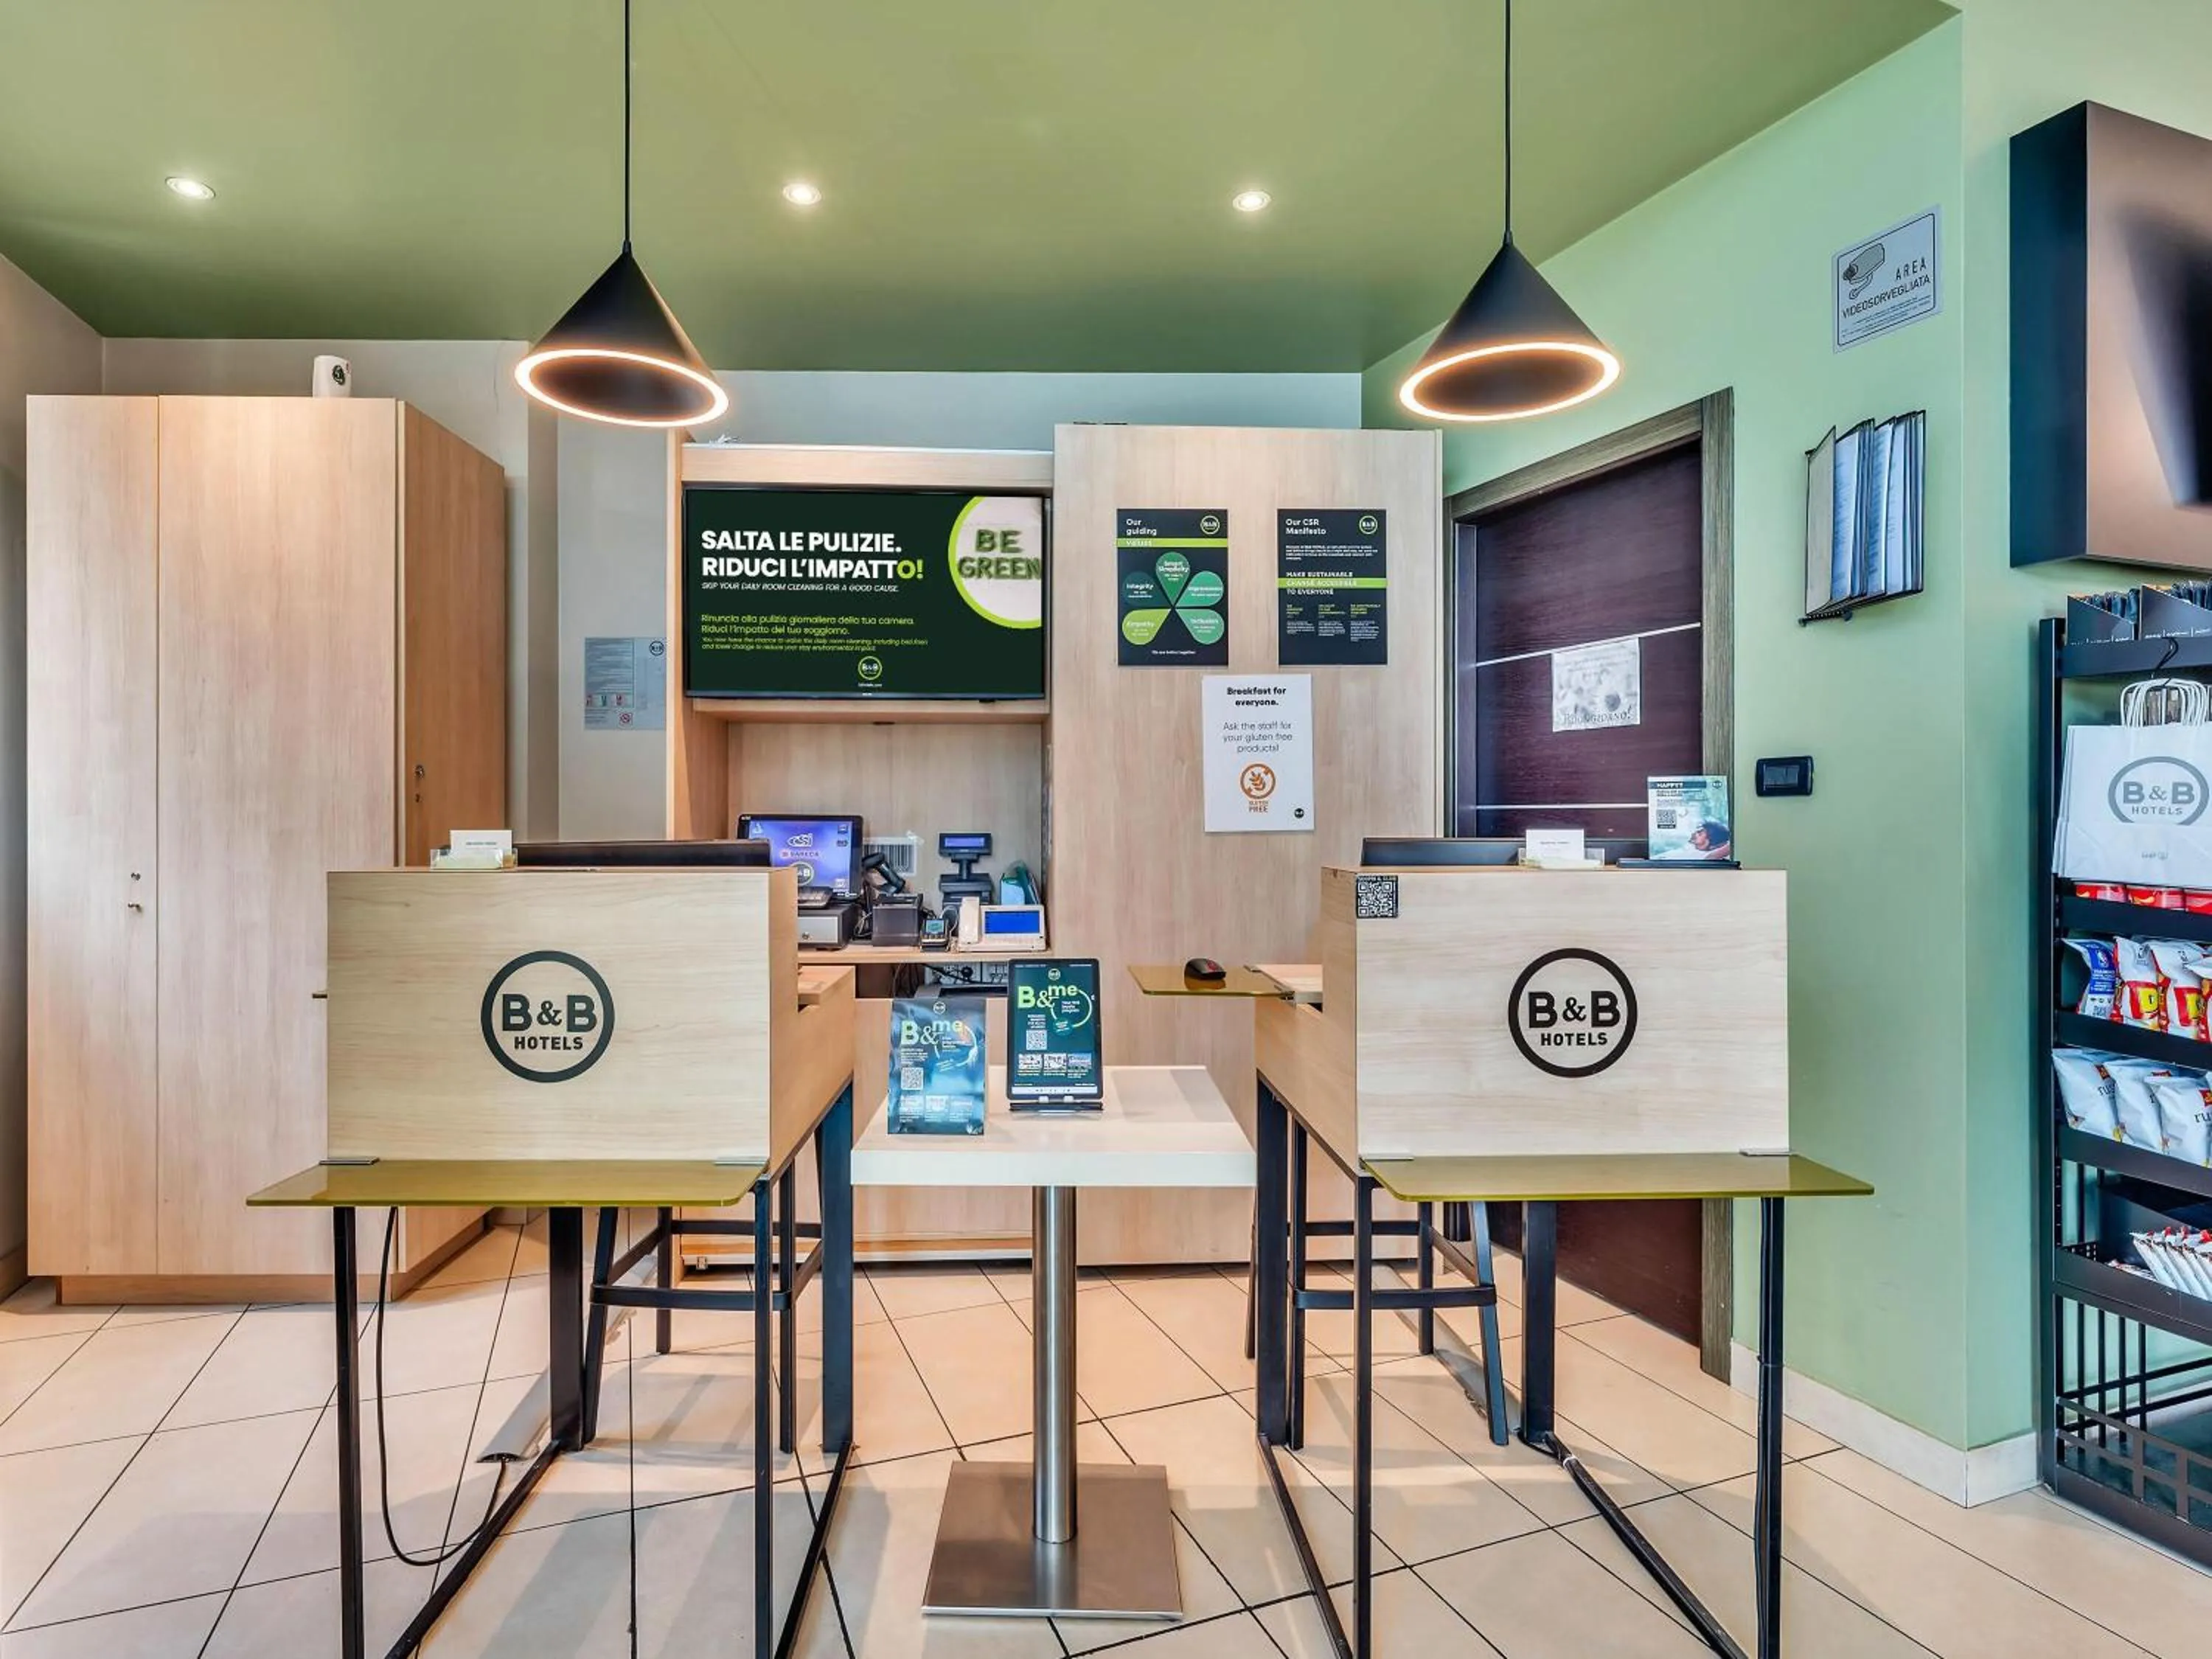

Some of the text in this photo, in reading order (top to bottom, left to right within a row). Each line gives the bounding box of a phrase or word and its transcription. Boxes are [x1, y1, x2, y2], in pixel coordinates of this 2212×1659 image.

[1895, 257, 1927, 281] AREA
[1842, 274, 1931, 319] VIDEOSORVEGLIATA
[1126, 527, 1157, 536] guiding
[701, 529, 902, 552] SALTA LE PULIZIE.
[975, 529, 1024, 554] BE
[701, 557, 924, 580] RIDUCI L'IMPATTO!
[958, 556, 1041, 580] GREEN
[762, 582, 786, 591] ROOM
[701, 614, 740, 623] Rinuncia
[741, 615, 757, 623] alla
[759, 614, 787, 625] pulizia
[789, 615, 836, 626] giornaliera
[838, 616, 860, 625] della
[701, 625, 728, 633] Riduci
[771, 625, 785, 634] del
[787, 626, 802, 634] tuo
[803, 626, 850, 636] soggiorno.
[1227, 686, 1287, 695] Breakfast for
[1235, 699, 1279, 707] everyone.
[1223, 721, 1292, 730] Ask the staff for
[1223, 733, 1293, 743] your gluten free
[1237, 744, 1280, 754] products!
[2123, 781, 2195, 804] B&B
[2131, 807, 2183, 815] HOTELS
[1018, 984, 1077, 1009] B&me
[502, 993, 597, 1032] B&B
[1528, 990, 1621, 1029] B&B
[901, 1020, 963, 1045] B&me
[1540, 1032, 1608, 1046] HOTELS
[514, 1036, 583, 1050] HOTELS
